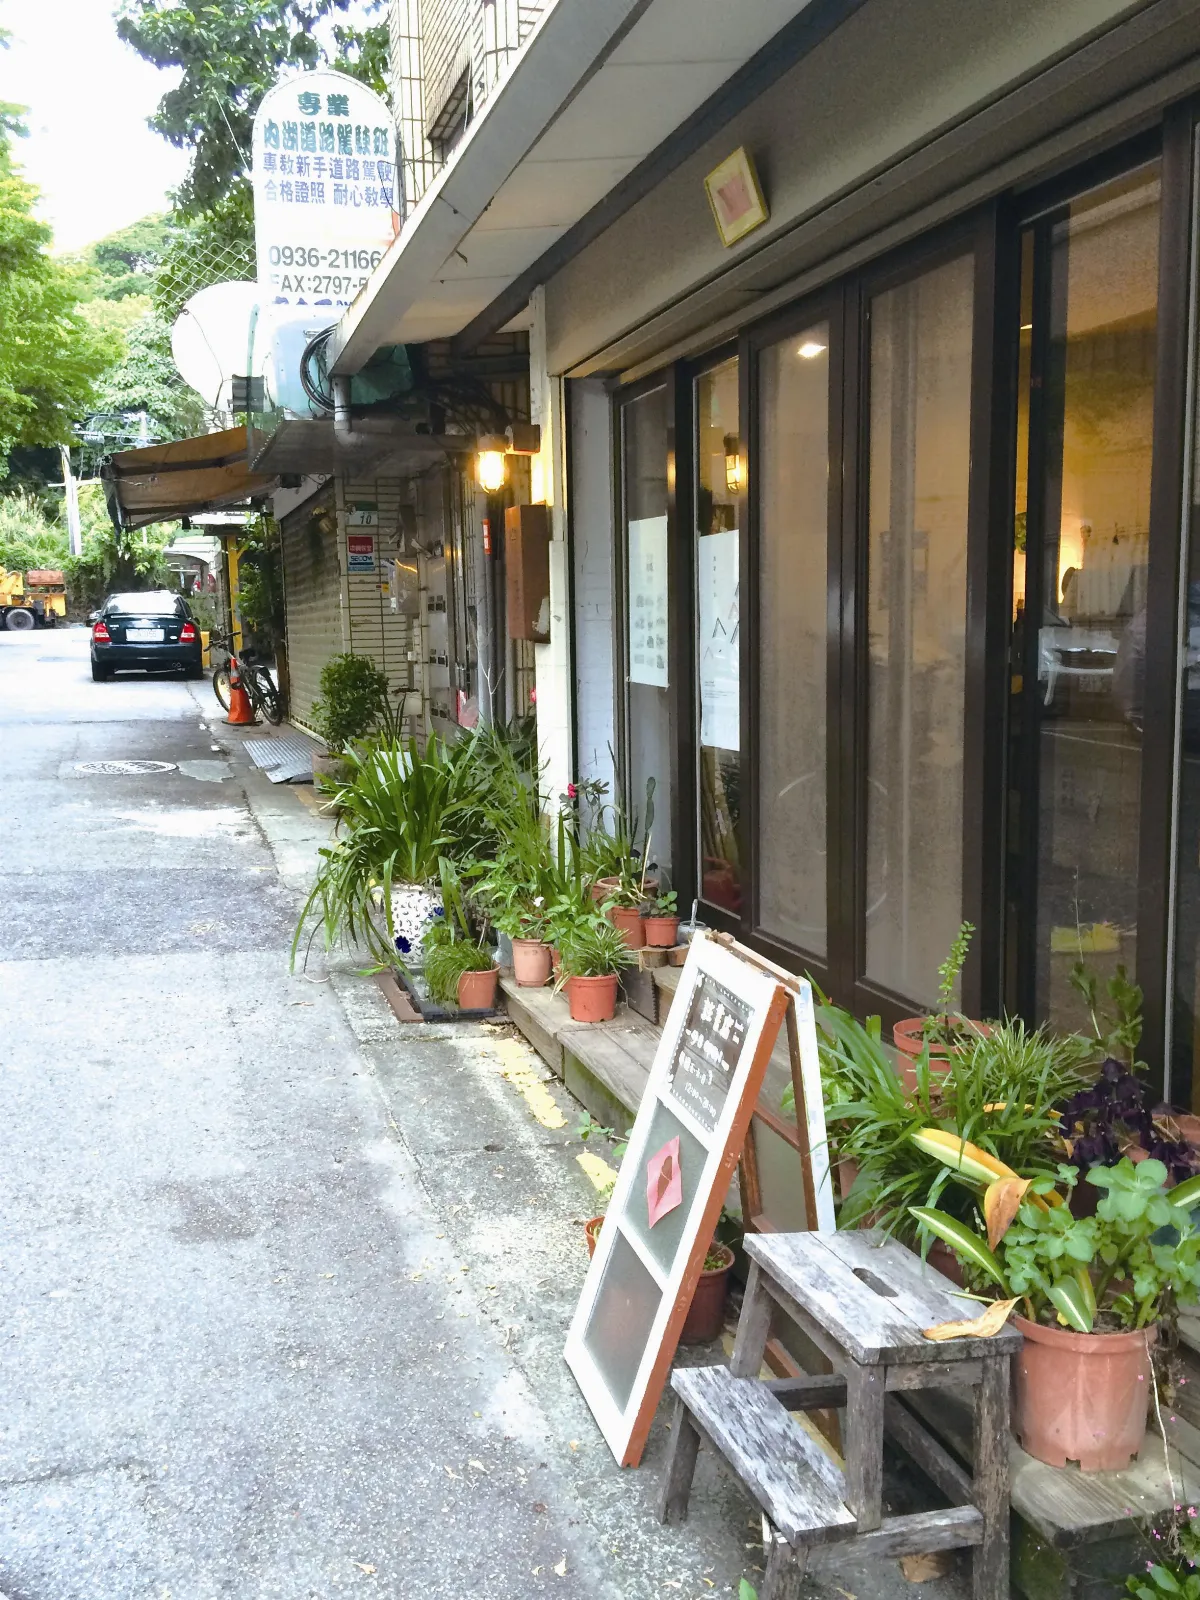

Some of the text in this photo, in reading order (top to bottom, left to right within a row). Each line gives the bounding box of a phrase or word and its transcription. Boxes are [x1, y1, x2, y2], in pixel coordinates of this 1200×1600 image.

[264, 179, 394, 208] 合格證照 耐心教學
